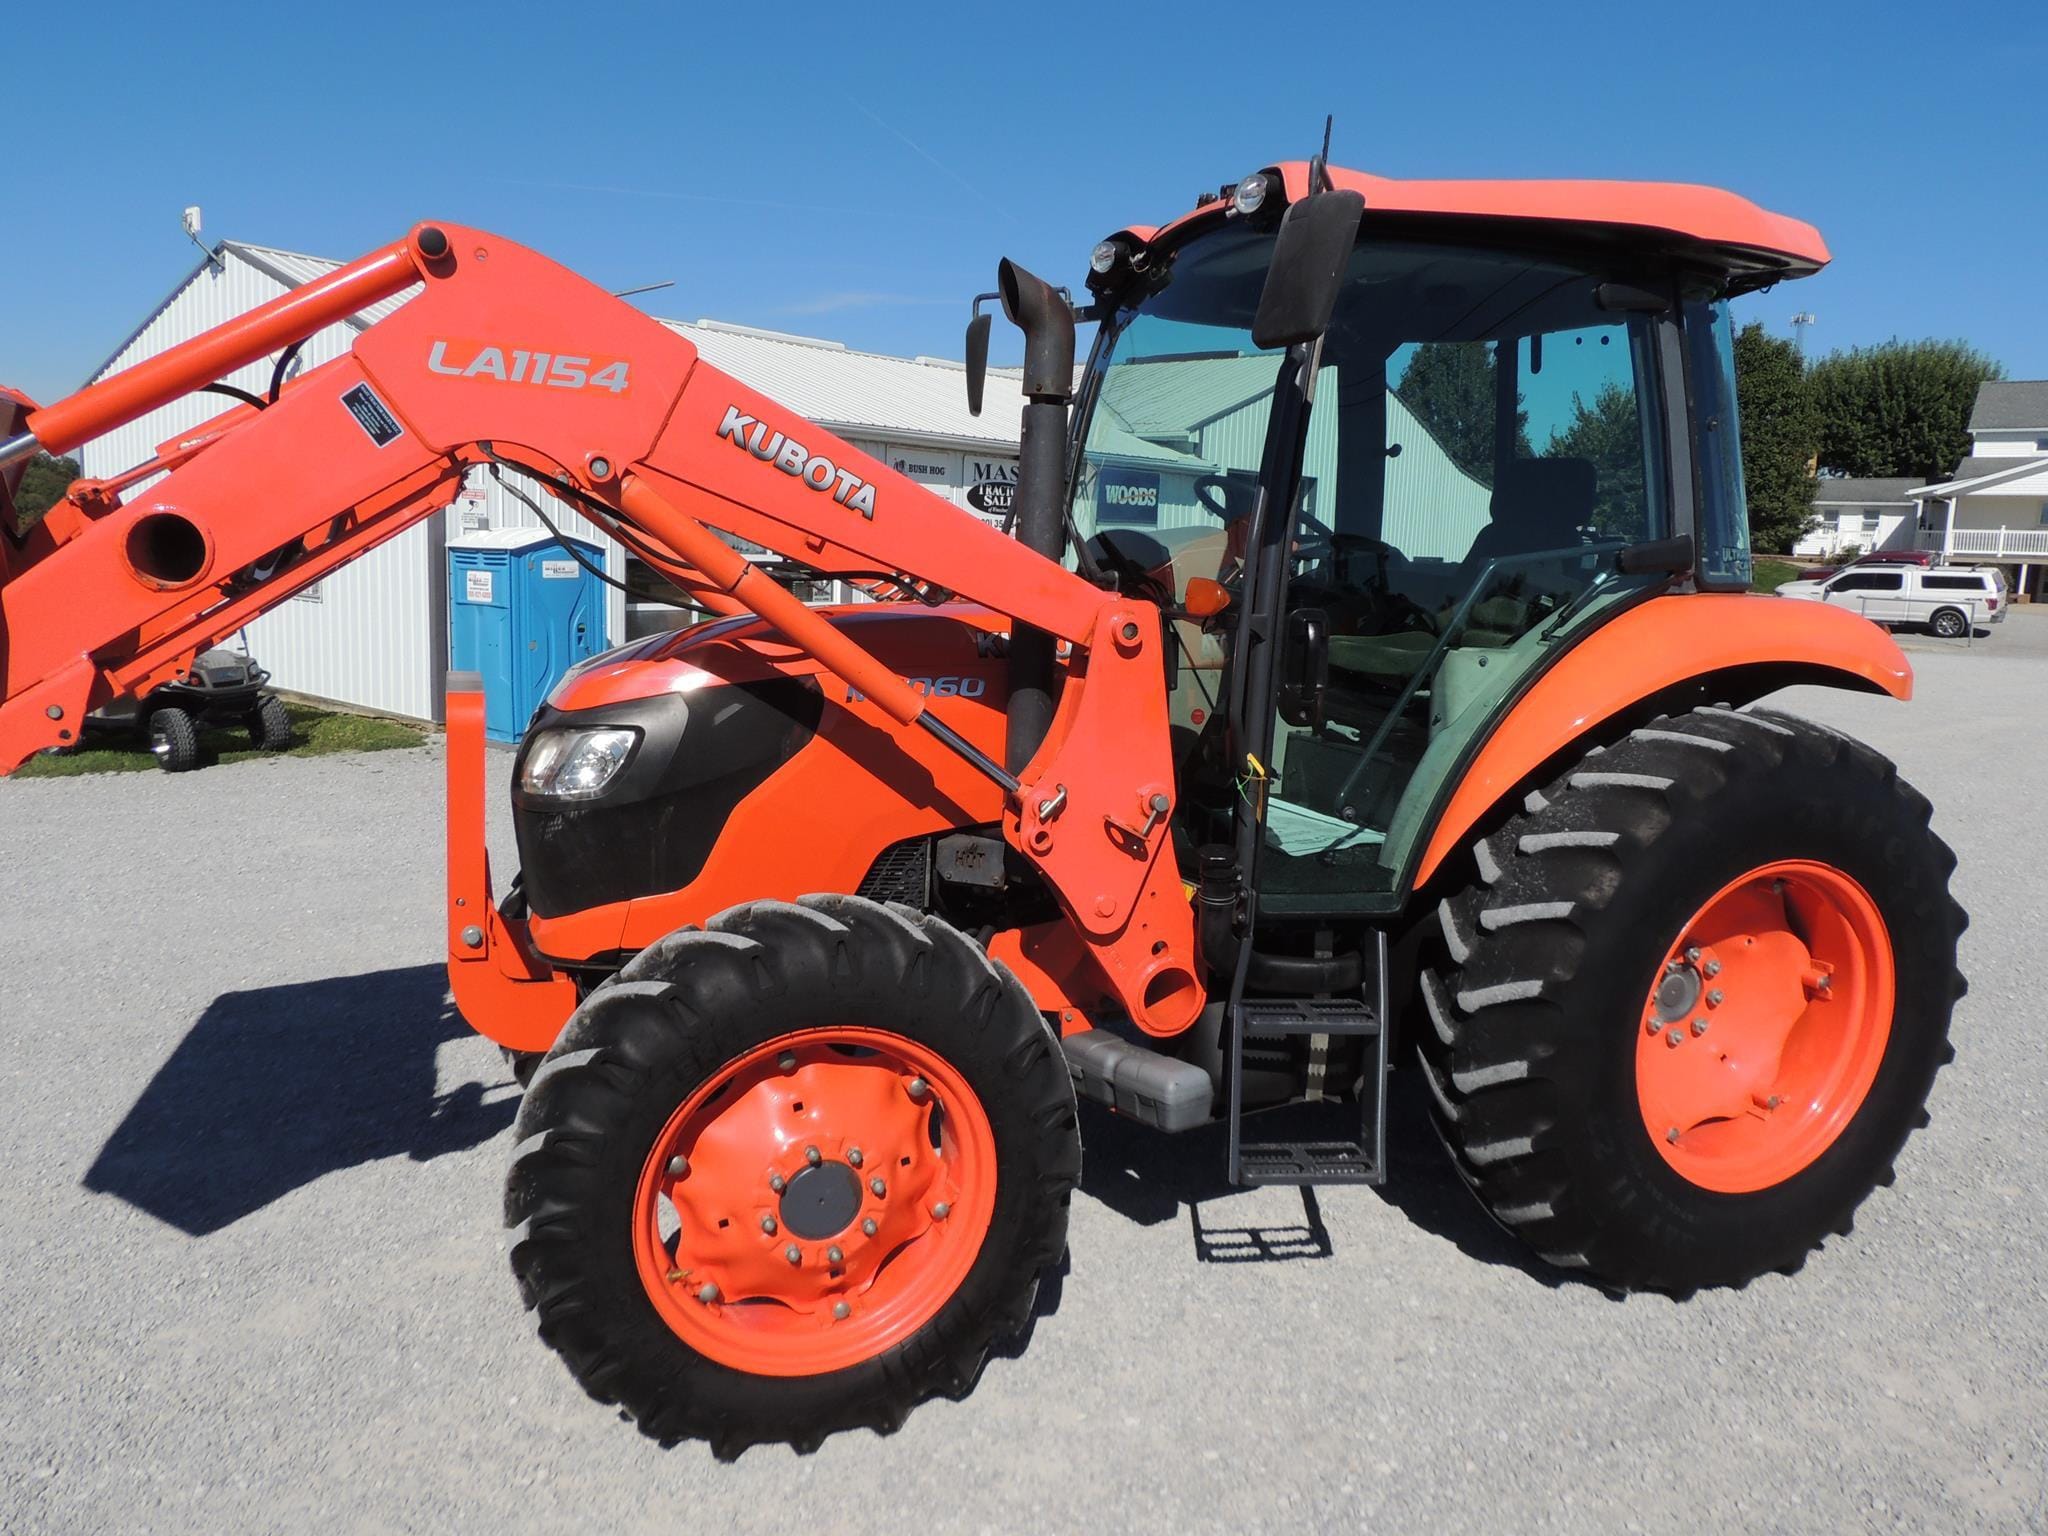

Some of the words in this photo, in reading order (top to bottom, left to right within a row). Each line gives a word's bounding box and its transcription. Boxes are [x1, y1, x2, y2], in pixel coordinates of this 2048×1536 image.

[428, 341, 630, 393] LA1154
[716, 404, 877, 522] KUBOTA
[908, 463, 928, 475] BUSH
[929, 465, 945, 476] HOG
[1105, 485, 1157, 507] WOODS
